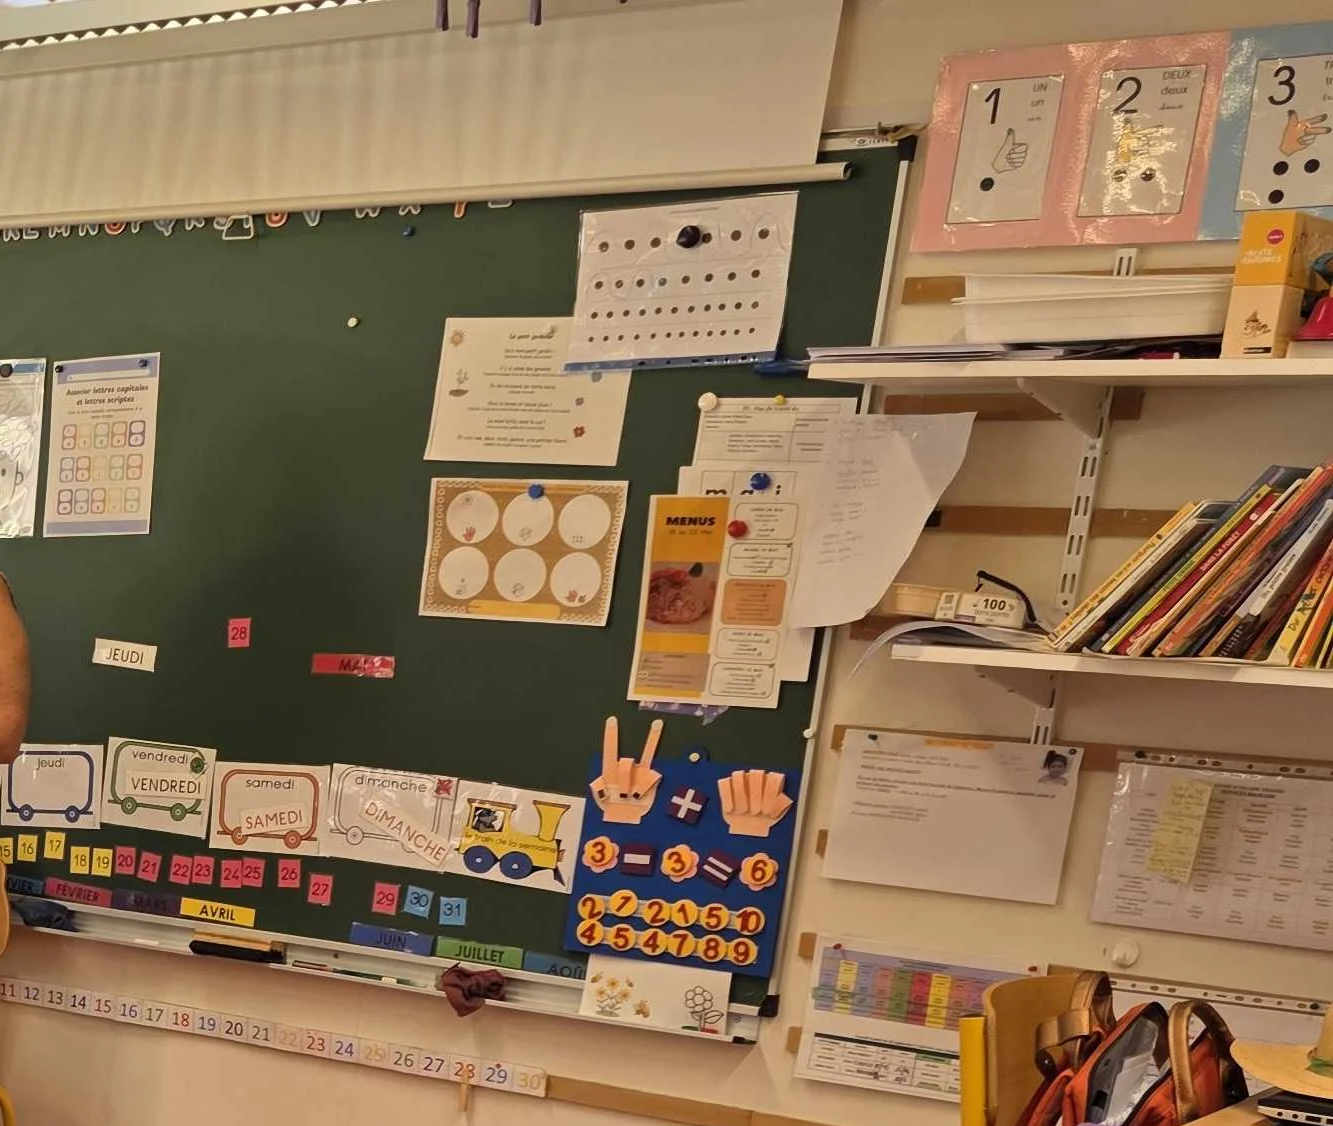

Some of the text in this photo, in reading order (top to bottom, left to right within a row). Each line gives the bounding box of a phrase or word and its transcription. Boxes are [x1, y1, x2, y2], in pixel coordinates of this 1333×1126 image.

[1162, 70, 1193, 80] DEUX
[1268, 65, 1295, 106] 3
[1115, 76, 1142, 114] 2
[1160, 85, 1189, 95] deux
[984, 87, 1002, 124] 1
[92, 384, 115, 395] lettres
[116, 384, 149, 395] capitales
[666, 516, 717, 527] MENUS
[983, 598, 1007, 611] 100
[105, 646, 144, 665] JEUDI
[230, 626, 247, 641] 28
[37, 757, 65, 770] jeudi
[132, 750, 189, 765] vendredi
[131, 777, 202, 795] VENDREDI
[245, 777, 295, 790] samedi
[355, 775, 429, 793] dimanche
[245, 809, 303, 830] SAMEDI
[364, 801, 446, 862] DIMANCHE
[590, 841, 607, 863] 3
[667, 851, 686, 874] 3
[749, 859, 768, 882] 6
[21, 842, 34, 855] 16
[48, 839, 62, 852] 17
[74, 854, 88, 868] 18
[96, 856, 110, 869] 19
[117, 854, 134, 868] 20
[141, 859, 158, 875] 21
[173, 863, 190, 878] 22
[195, 863, 211, 877] 23
[223, 867, 240, 881] 24
[244, 864, 261, 880] 25
[281, 867, 298, 881] 26
[311, 882, 329, 896] 27
[376, 892, 395, 907] 29
[408, 891, 430, 908] 30
[442, 903, 462, 917] 31
[55, 883, 101, 902] FÉVRIER
[199, 904, 237, 922] AVRIL
[376, 932, 407, 949] JUIN
[454, 944, 507, 965] JUILLET
[582, 896, 603, 919] 2
[647, 900, 666, 925] 2
[677, 903, 689, 923] 1
[706, 906, 723, 930] 5
[736, 911, 761, 932] 10
[580, 923, 751, 964] 4 5 4 7 8 9
[0, 982, 17, 998] 11
[23, 986, 40, 1001] 12
[47, 990, 64, 1006] 13
[70, 994, 87, 1010] 14
[94, 998, 112, 1014] 15
[120, 1003, 138, 1019] 16
[145, 1007, 164, 1023] 17
[171, 1012, 190, 1028] 18
[197, 1016, 217, 1032] 19
[224, 1020, 244, 1037] 20
[251, 1025, 271, 1042] 21
[278, 1030, 299, 1047] 22
[306, 1035, 326, 1052] 23
[334, 1040, 355, 1057] 24
[363, 1045, 384, 1062] 25
[393, 1050, 415, 1068] 26
[422, 1056, 445, 1074] 27
[453, 1061, 476, 1079] 28
[484, 1066, 508, 1085] 29
[517, 1072, 541, 1090] 30
